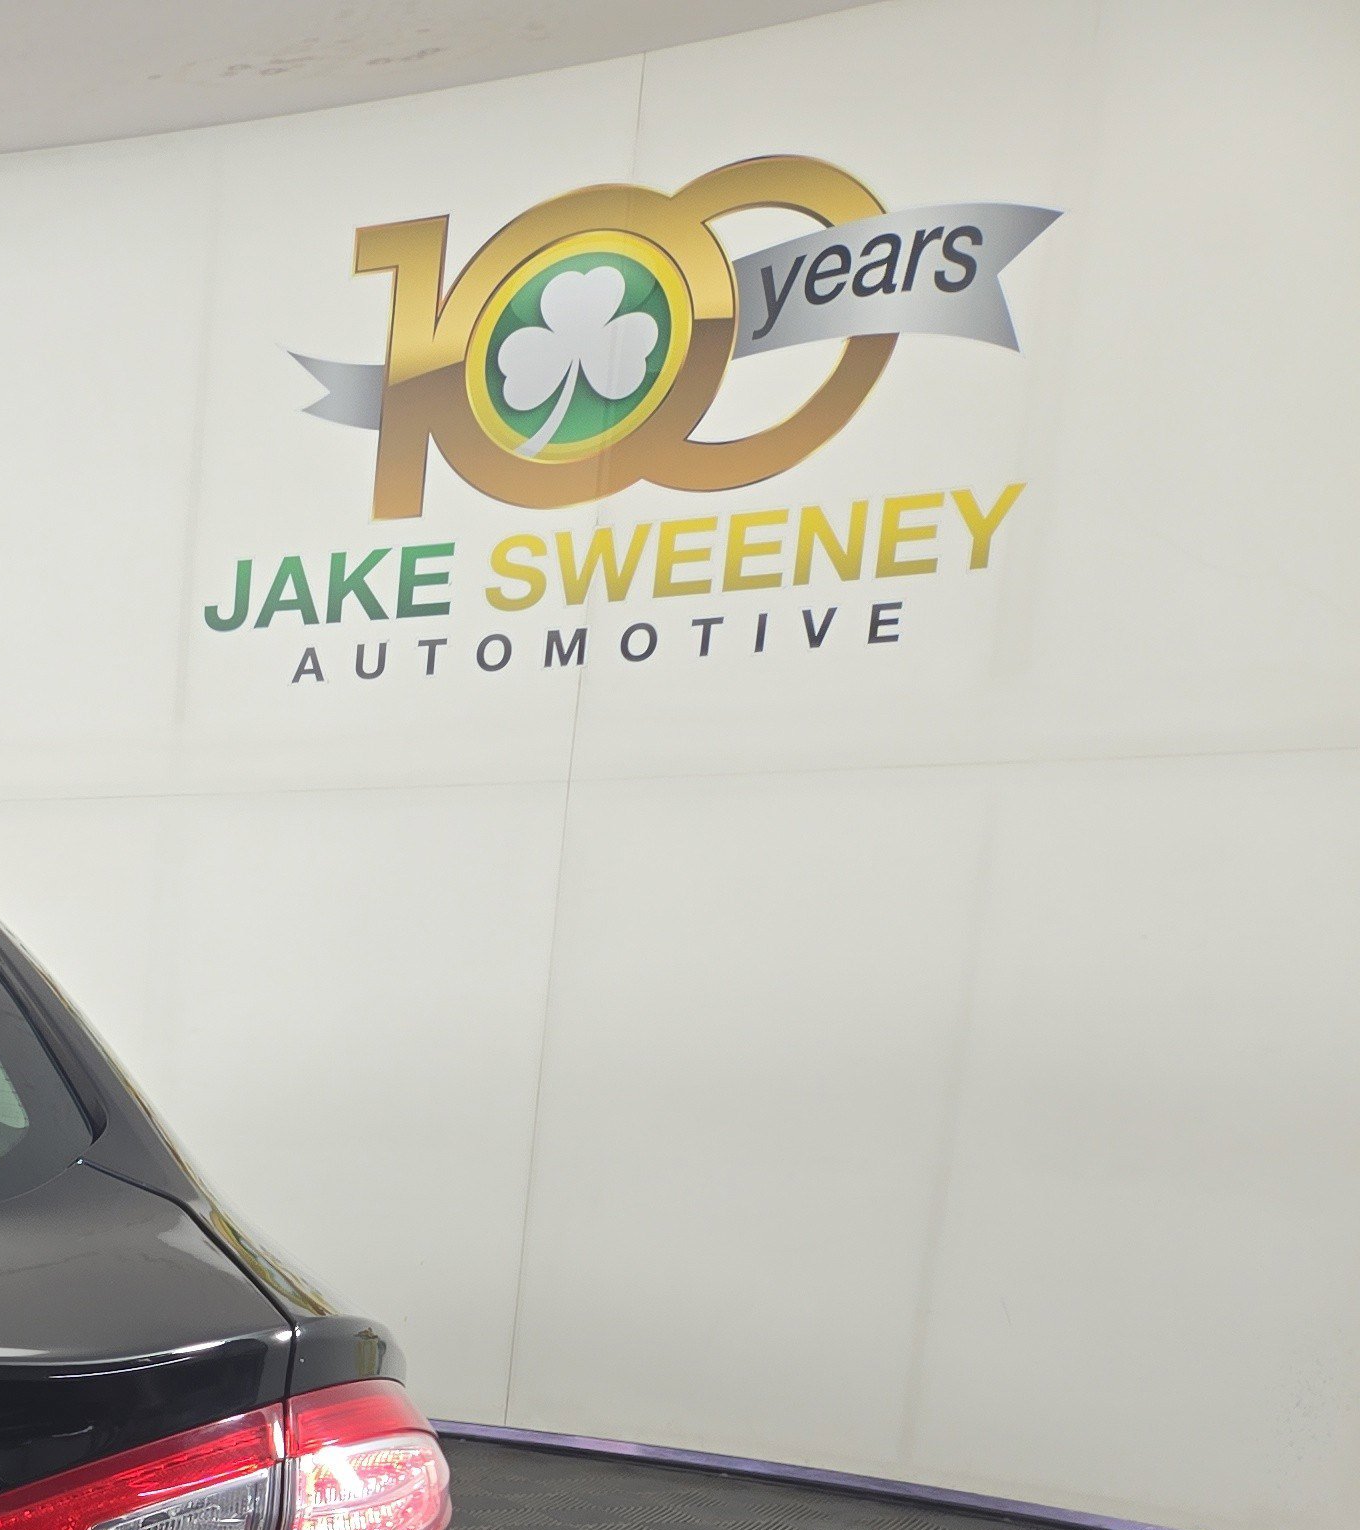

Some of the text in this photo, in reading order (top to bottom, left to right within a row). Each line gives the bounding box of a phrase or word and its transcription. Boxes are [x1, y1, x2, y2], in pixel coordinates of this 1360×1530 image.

[352, 154, 899, 521] 100
[751, 223, 982, 340] years
[203, 483, 1027, 632] JAKE SWEENEY
[290, 601, 905, 685] AUTOMOTIVE
